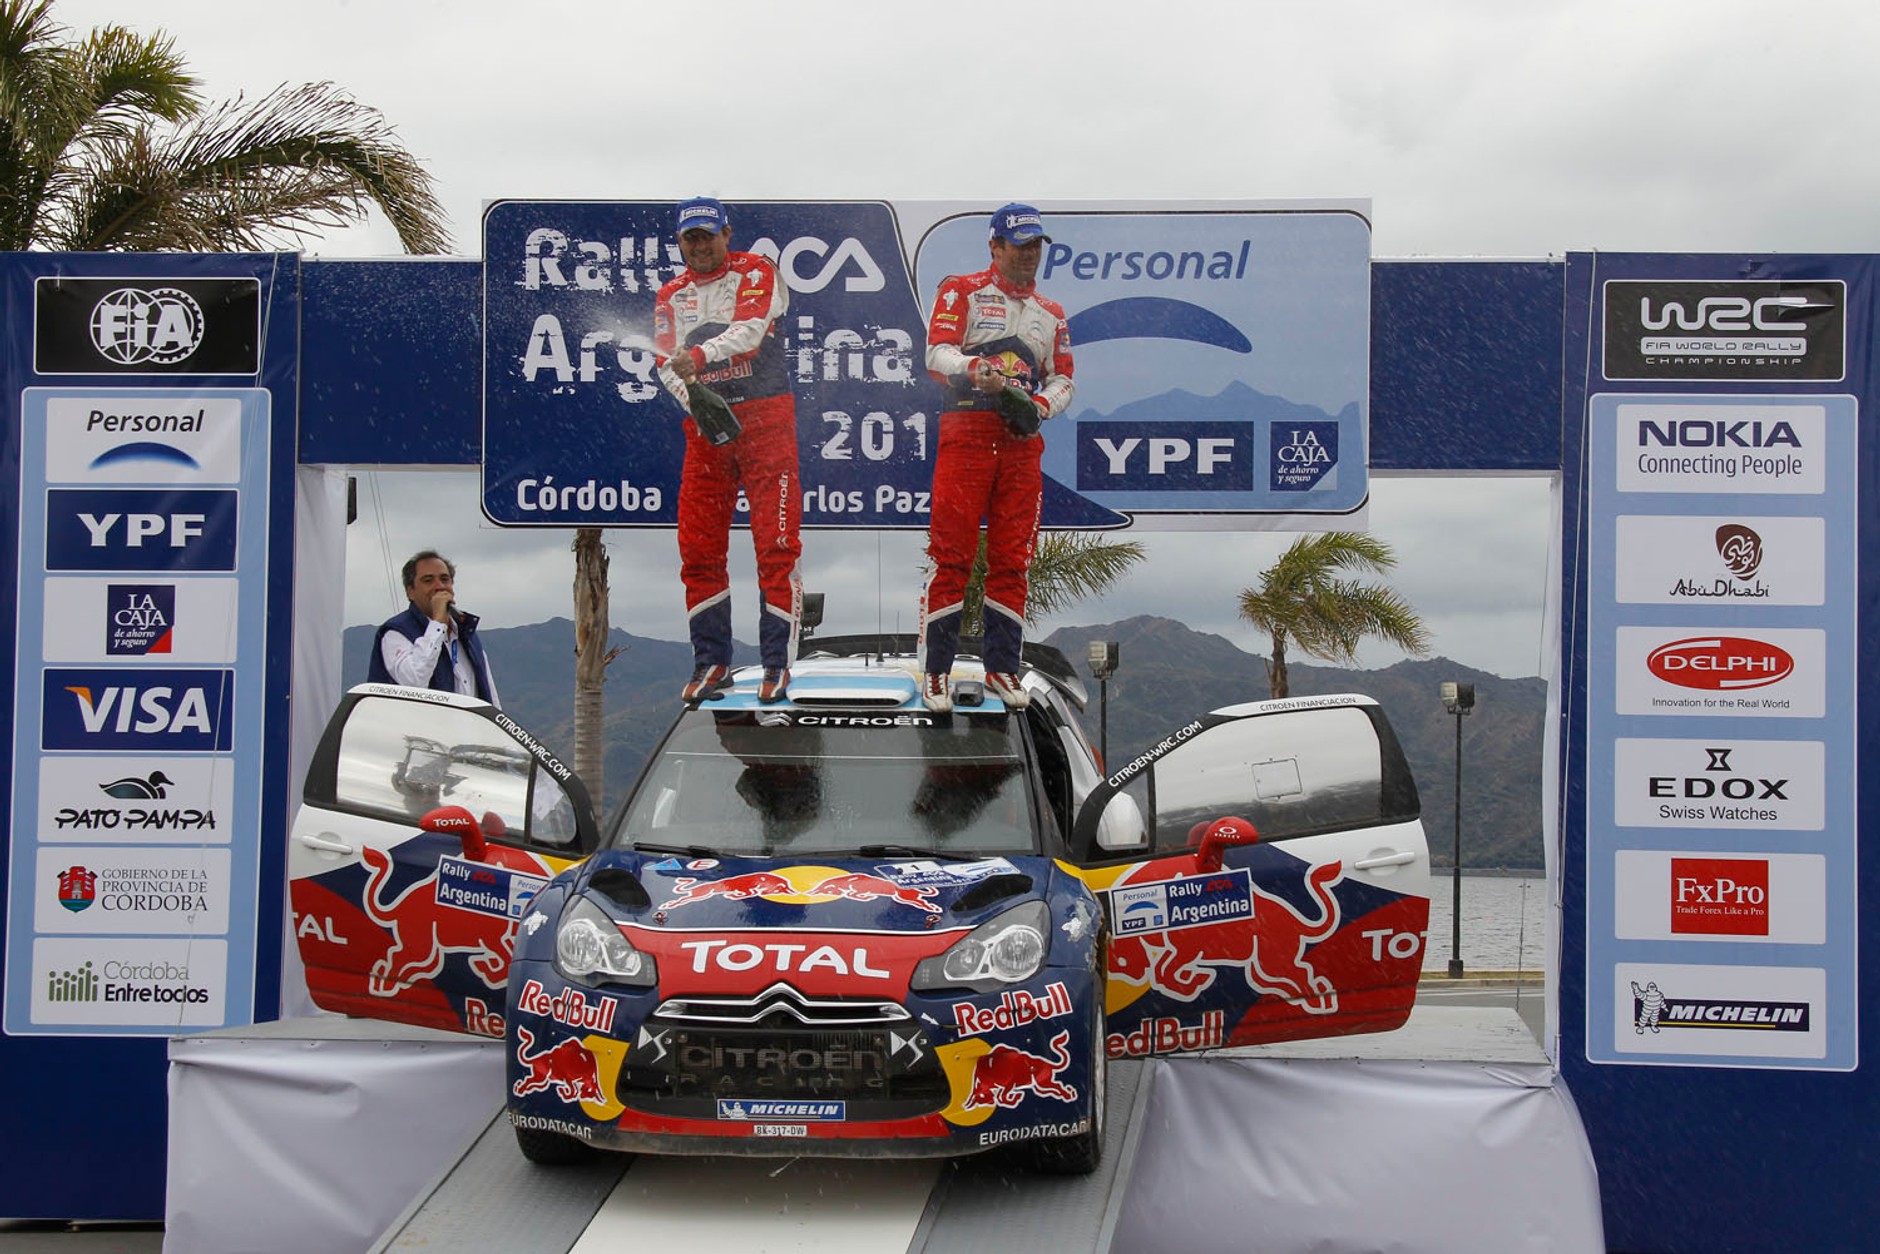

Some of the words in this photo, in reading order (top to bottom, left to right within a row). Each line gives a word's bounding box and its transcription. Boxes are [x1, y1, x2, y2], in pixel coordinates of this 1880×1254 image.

[1043, 240, 1251, 281] Personal
[1641, 296, 1807, 331] WRC
[1646, 342, 1671, 350] FIA
[1676, 342, 1737, 351] WORLD
[1742, 342, 1801, 351] RALLY
[523, 314, 916, 403] Argina
[1646, 357, 1801, 365] CHAMPIONSHIP
[87, 410, 204, 432] Personal
[820, 411, 926, 460] 201
[1291, 430, 1320, 446] LA
[1638, 420, 1802, 448] NOKIA
[1093, 438, 1235, 474] YPF
[1278, 446, 1331, 467] CAJA
[1638, 453, 1736, 478] Connecting
[1742, 454, 1802, 478] People
[1278, 465, 1288, 474] de
[1289, 465, 1319, 474] ahorro
[517, 478, 661, 512] Córdoba
[803, 485, 864, 512] rlos
[876, 485, 931, 513] Paz
[77, 513, 205, 547] YPF
[128, 594, 157, 610] LA
[115, 609, 167, 630] CAJA
[114, 628, 125, 637] de
[126, 628, 155, 637] ahorro
[121, 639, 147, 648] seguro
[1664, 655, 1776, 672] DELPHI
[64, 686, 212, 733] VISA
[1652, 697, 1701, 709] Innovation
[1703, 698, 1717, 708] for
[1719, 698, 1734, 708] the
[1737, 698, 1759, 708] Real
[1762, 698, 1789, 709] World
[798, 715, 932, 727] CITROËN
[495, 713, 572, 781] CITROEN-WRC.COM
[1108, 720, 1203, 787] CITROEN-WRC.COM
[1649, 777, 1788, 800] EDOX
[55, 808, 120, 830] PATO
[124, 808, 216, 830] PAMPA
[433, 818, 470, 826] TOTAL
[1659, 805, 1705, 819] Swiss
[1709, 805, 1777, 821] Watches
[102, 869, 167, 879] GOBIERNO
[171, 869, 188, 879] DE
[191, 870, 208, 880] LA
[442, 862, 471, 881] Rally
[102, 880, 185, 893] PROVINCIA
[189, 881, 208, 893] DE
[517, 880, 541, 891] Person
[1123, 889, 1157, 901] Personal
[1170, 882, 1202, 898] Rally
[1676, 877, 1764, 904] FxPro
[440, 882, 507, 912] Argentina
[1171, 899, 1249, 922] Argentina
[1676, 906, 1697, 914] Trade
[1700, 906, 1721, 915] Forex
[1724, 906, 1741, 915] Like
[1750, 907, 1764, 916] Pro
[1124, 919, 1144, 929] YPF
[681, 940, 890, 979] TOTAL
[104, 961, 189, 980] Córdoba
[518, 979, 569, 1021] Red
[567, 988, 617, 1033] Bull
[953, 991, 1013, 1037] Red
[1012, 981, 1073, 1026] Bull
[1668, 1002, 1804, 1023] MICHELIN
[465, 997, 506, 1037] Re
[1106, 1019, 1153, 1058] ed
[1156, 1010, 1224, 1053] Bull
[750, 1104, 838, 1115] MICHELIN
[508, 1112, 592, 1140] EURODATACAR
